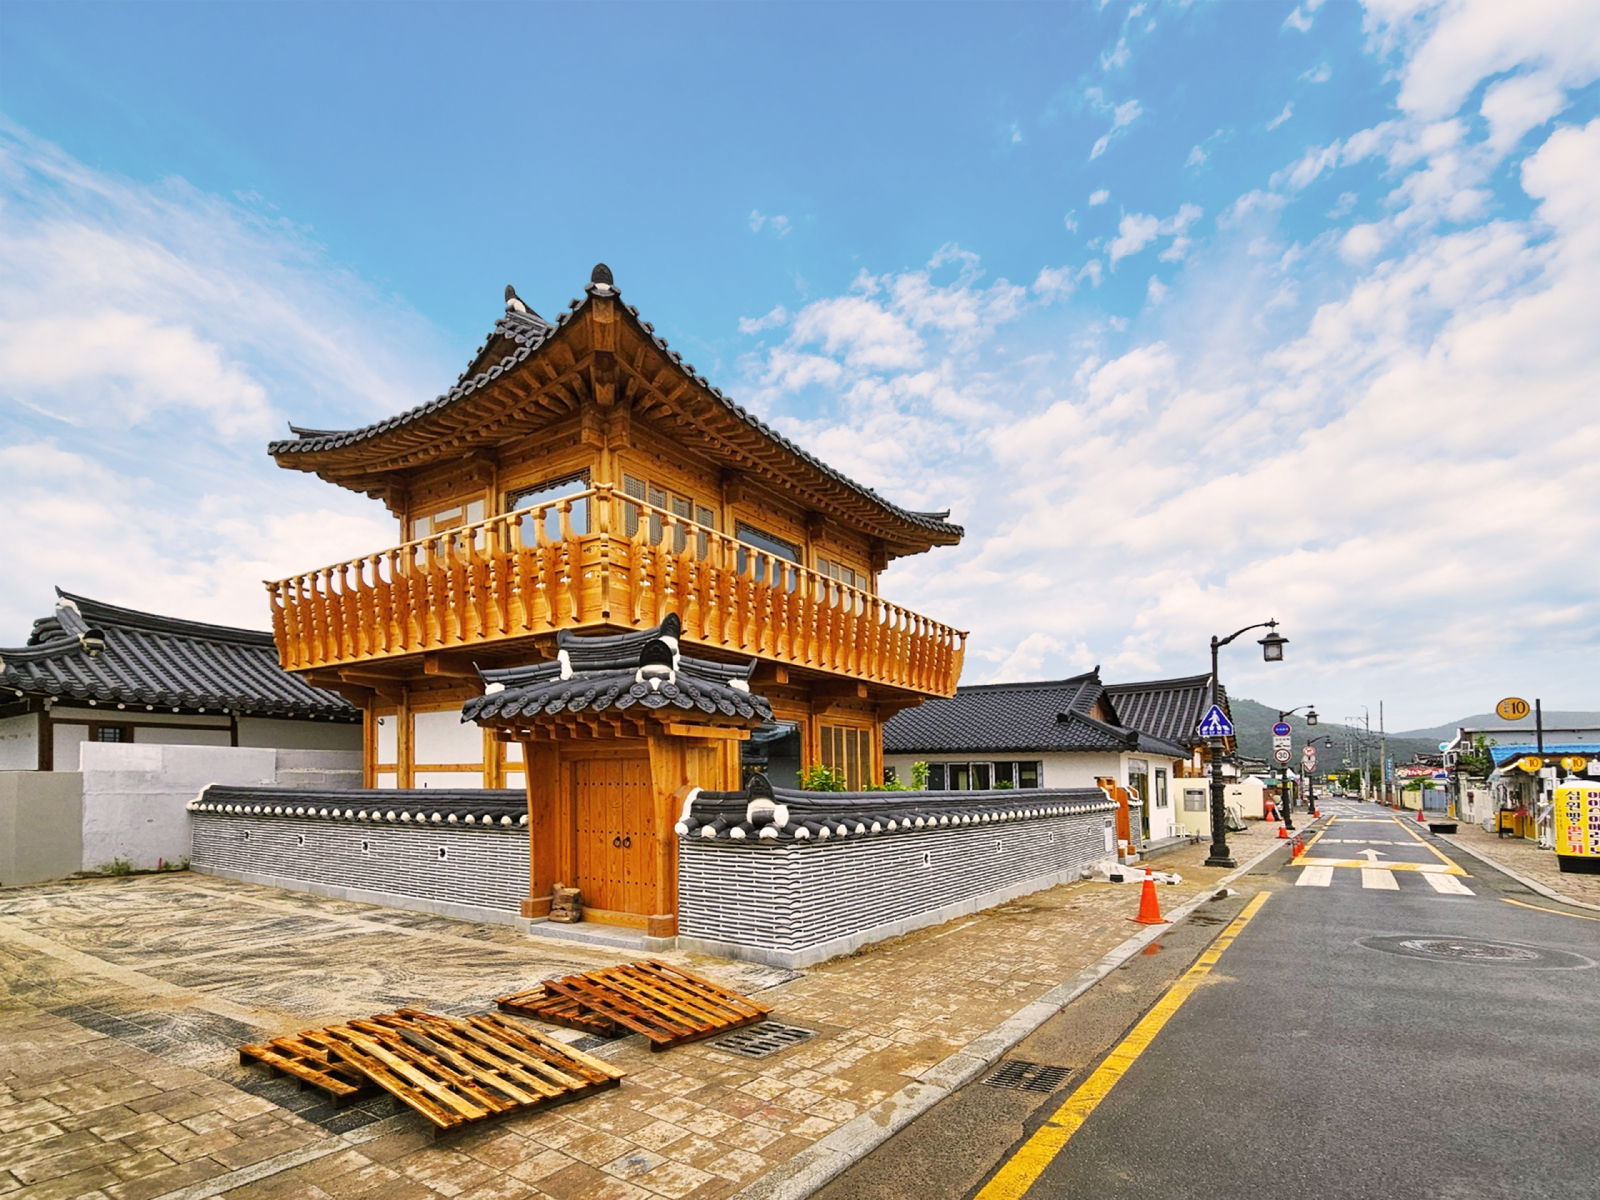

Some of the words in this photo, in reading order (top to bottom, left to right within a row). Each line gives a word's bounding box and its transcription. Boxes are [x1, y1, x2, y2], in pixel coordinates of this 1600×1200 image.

[1511, 702, 1526, 714] 10
[1529, 758, 1540, 768] 10
[1572, 757, 1583, 768] 10
